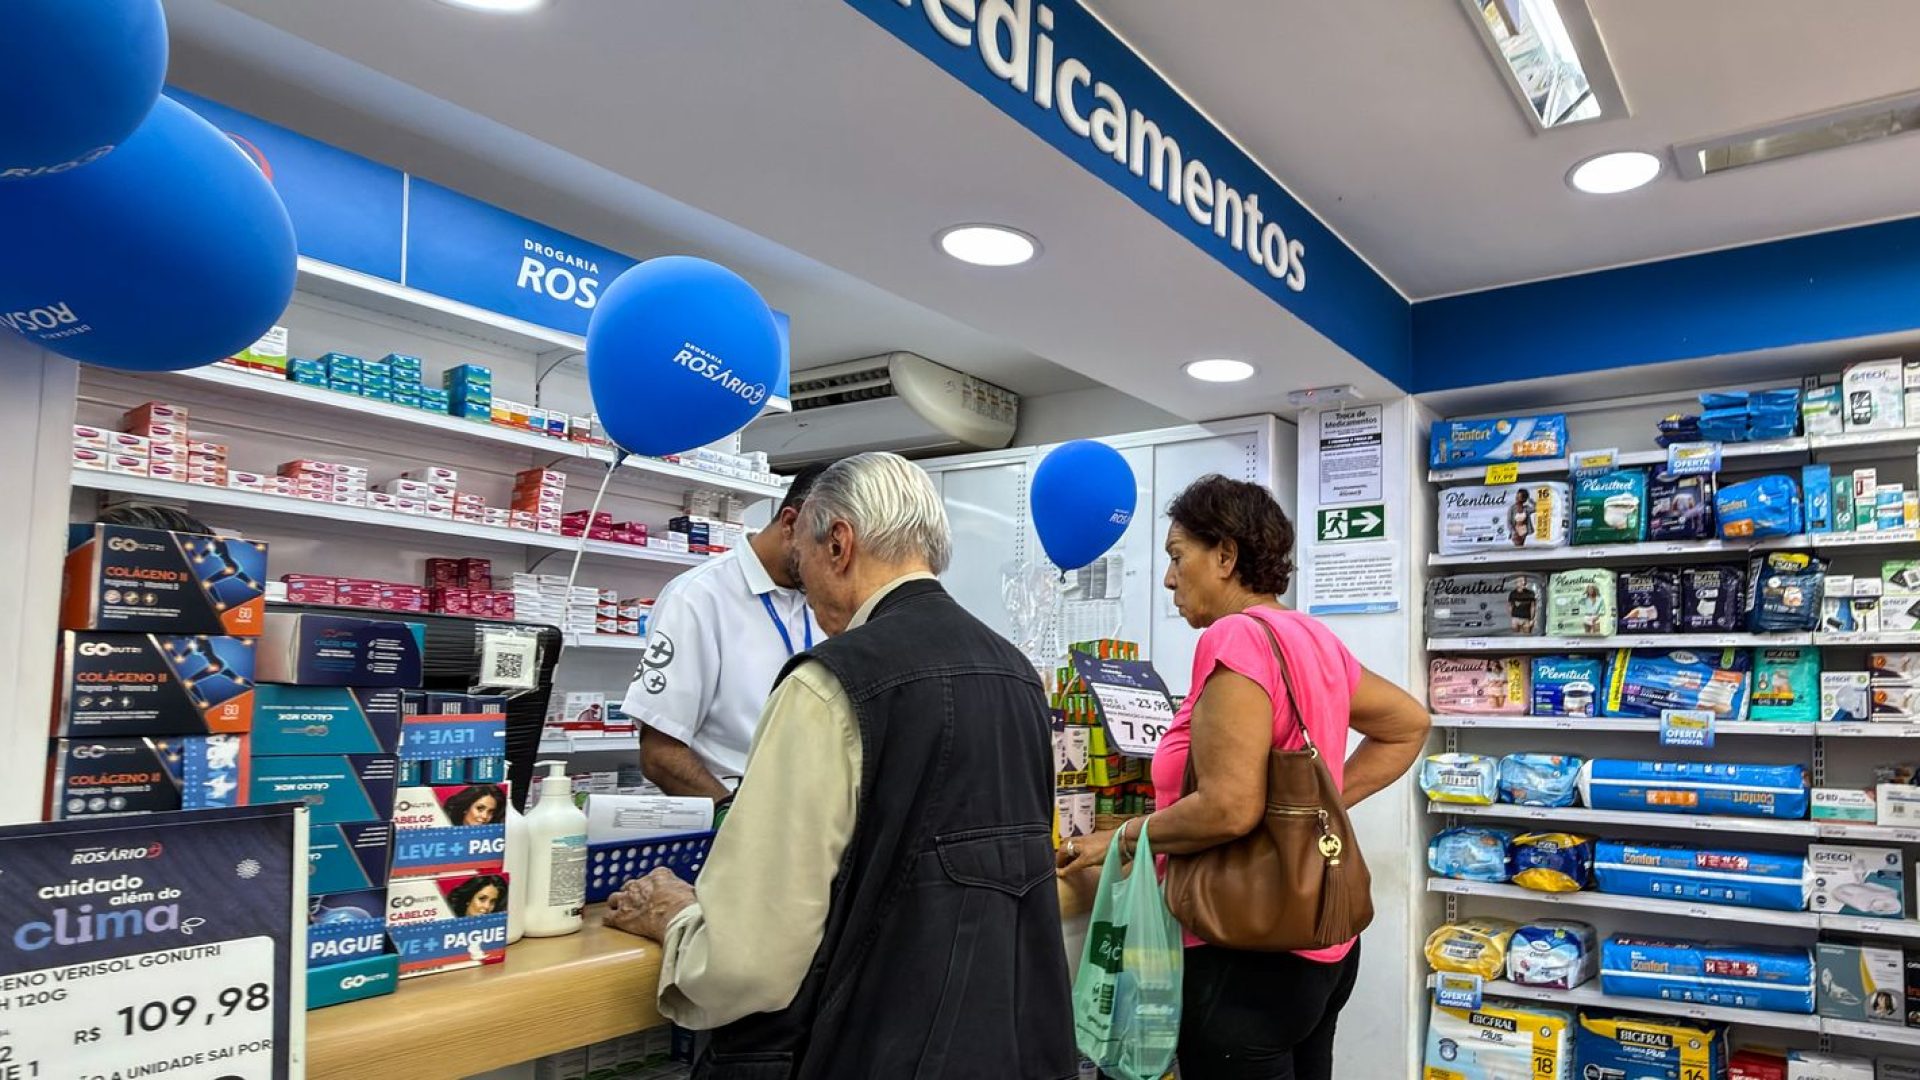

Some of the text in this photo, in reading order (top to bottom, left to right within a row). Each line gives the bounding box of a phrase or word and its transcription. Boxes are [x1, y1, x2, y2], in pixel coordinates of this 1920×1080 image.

[893, 0, 1307, 292] edicamentos
[524, 238, 599, 275] DROGARIA
[684, 341, 723, 365] DROGARIA
[672, 348, 752, 400] ROSÁRIO
[1324, 417, 1378, 429] Medicamentos
[1581, 477, 1635, 493] Plenitud
[1445, 490, 1508, 508] Plenitud
[104, 566, 178, 581] COLÁGENO
[1555, 574, 1597, 586] Plenitud
[1433, 577, 1507, 596] Plenitud
[238, 607, 253, 620] 60
[78, 642, 143, 657] GONUTRI
[1433, 659, 1484, 673] Plenitud
[1538, 665, 1591, 680] Plenitud
[76, 670, 155, 683] COLÁGENO
[223, 704, 239, 717] 60
[429, 728, 475, 745] LEVE
[1666, 728, 1704, 739] OFERTA
[68, 772, 149, 786] COLÁGENO
[394, 814, 434, 824] ABELOS
[70, 846, 148, 866] ROSÁRIO
[397, 842, 446, 860] LEVE
[468, 837, 506, 855] PAG
[1623, 852, 1661, 866] Confort
[1815, 851, 1852, 863] G-TECH
[38, 874, 144, 900] cuidado
[108, 887, 182, 907] além do
[389, 908, 438, 922] CABELOS
[13, 902, 180, 952] clima
[443, 925, 506, 950] PAGUE
[309, 933, 385, 960] PAGUE
[0, 944, 222, 992] ENO VERISOL GONUTRI
[1631, 960, 1669, 973] Confort
[15, 988, 69, 1008] 120G
[1440, 990, 1473, 1002] OFERTA
[73, 982, 271, 1046] R$ 109,98
[1472, 1014, 1514, 1031] BIGFRAL
[1480, 1029, 1503, 1042] Plus
[1619, 1030, 1669, 1046] BIGFRAL
[1646, 1048, 1666, 1059] Plus
[28, 1060, 39, 1077] 1
[127, 1053, 206, 1080] UNIDADE
[208, 1046, 234, 1062] SAI
[1533, 1056, 1554, 1074] 18
[1684, 1068, 1704, 1080] 16
